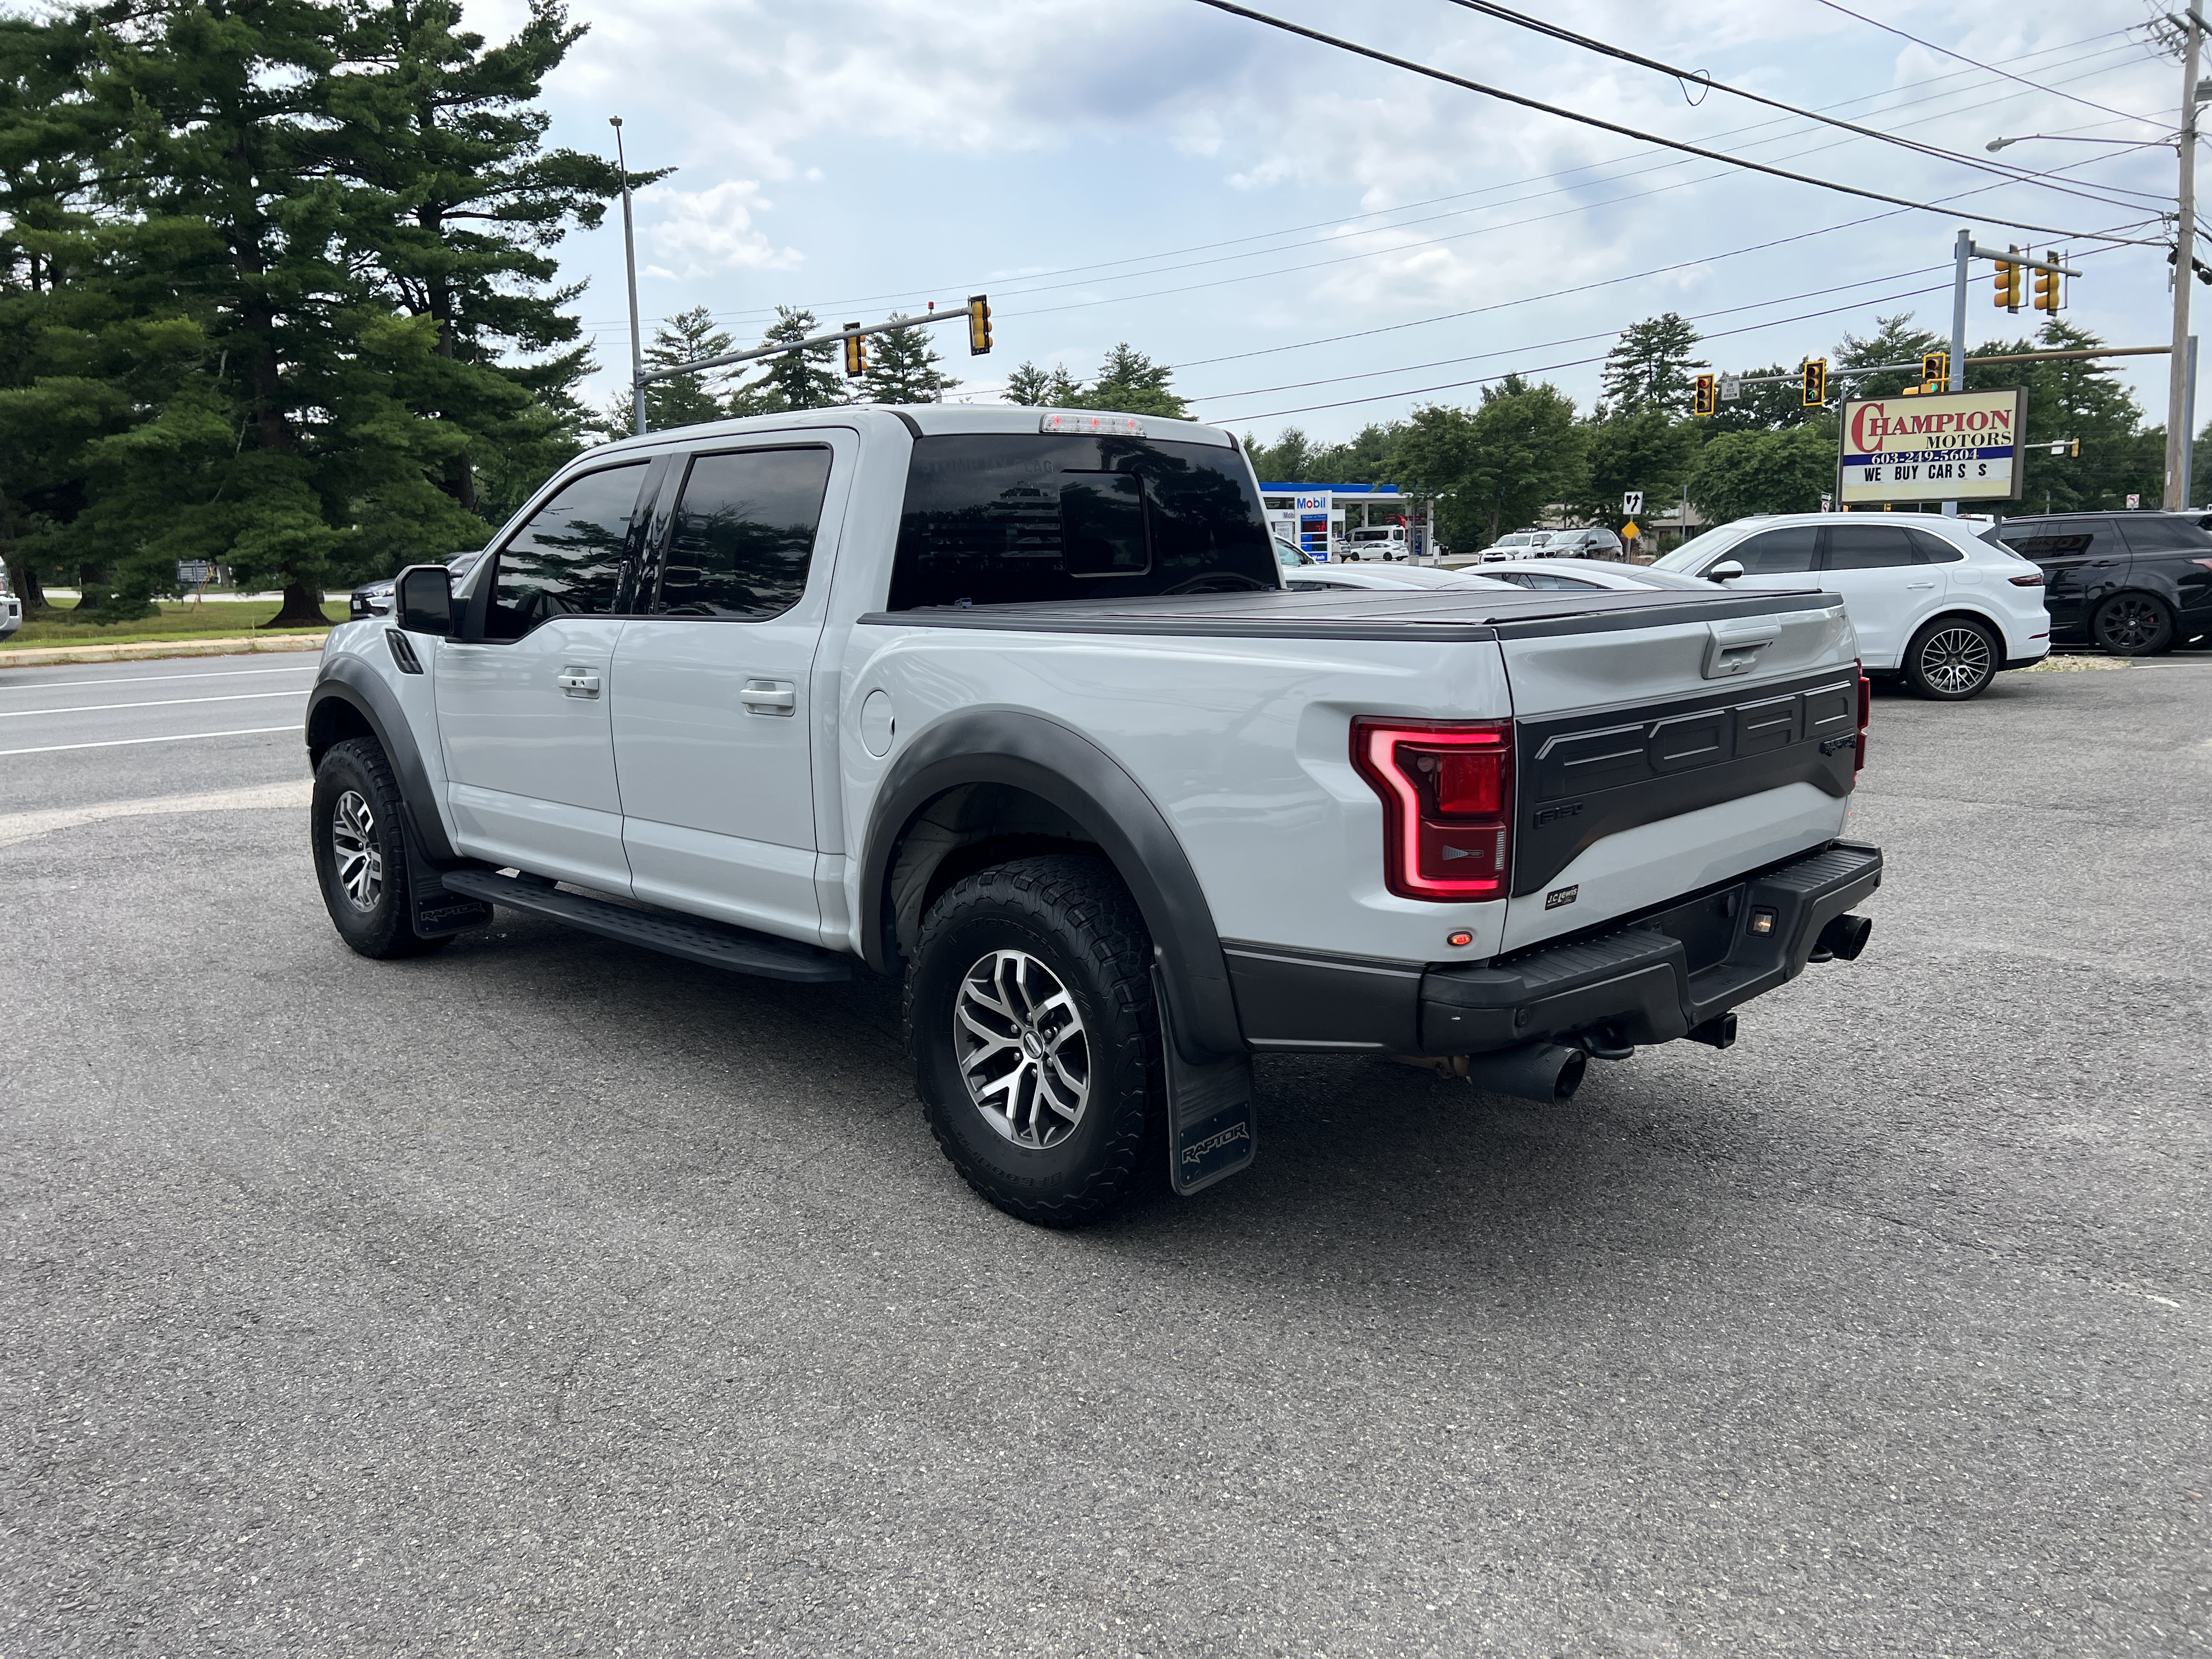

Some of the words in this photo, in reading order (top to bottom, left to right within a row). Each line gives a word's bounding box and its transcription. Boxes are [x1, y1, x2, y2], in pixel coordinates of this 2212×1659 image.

[1926, 431, 2012, 449] MOTORS
[1871, 448, 1979, 465] 603-249-5604
[1865, 467, 1882, 482] WE
[1895, 465, 1919, 481] BUY
[1297, 497, 1326, 509] Mobil
[1534, 680, 1852, 804] FORD
[420, 901, 486, 923] RAPTOR
[1181, 1121, 1250, 1165] RAPTOR
